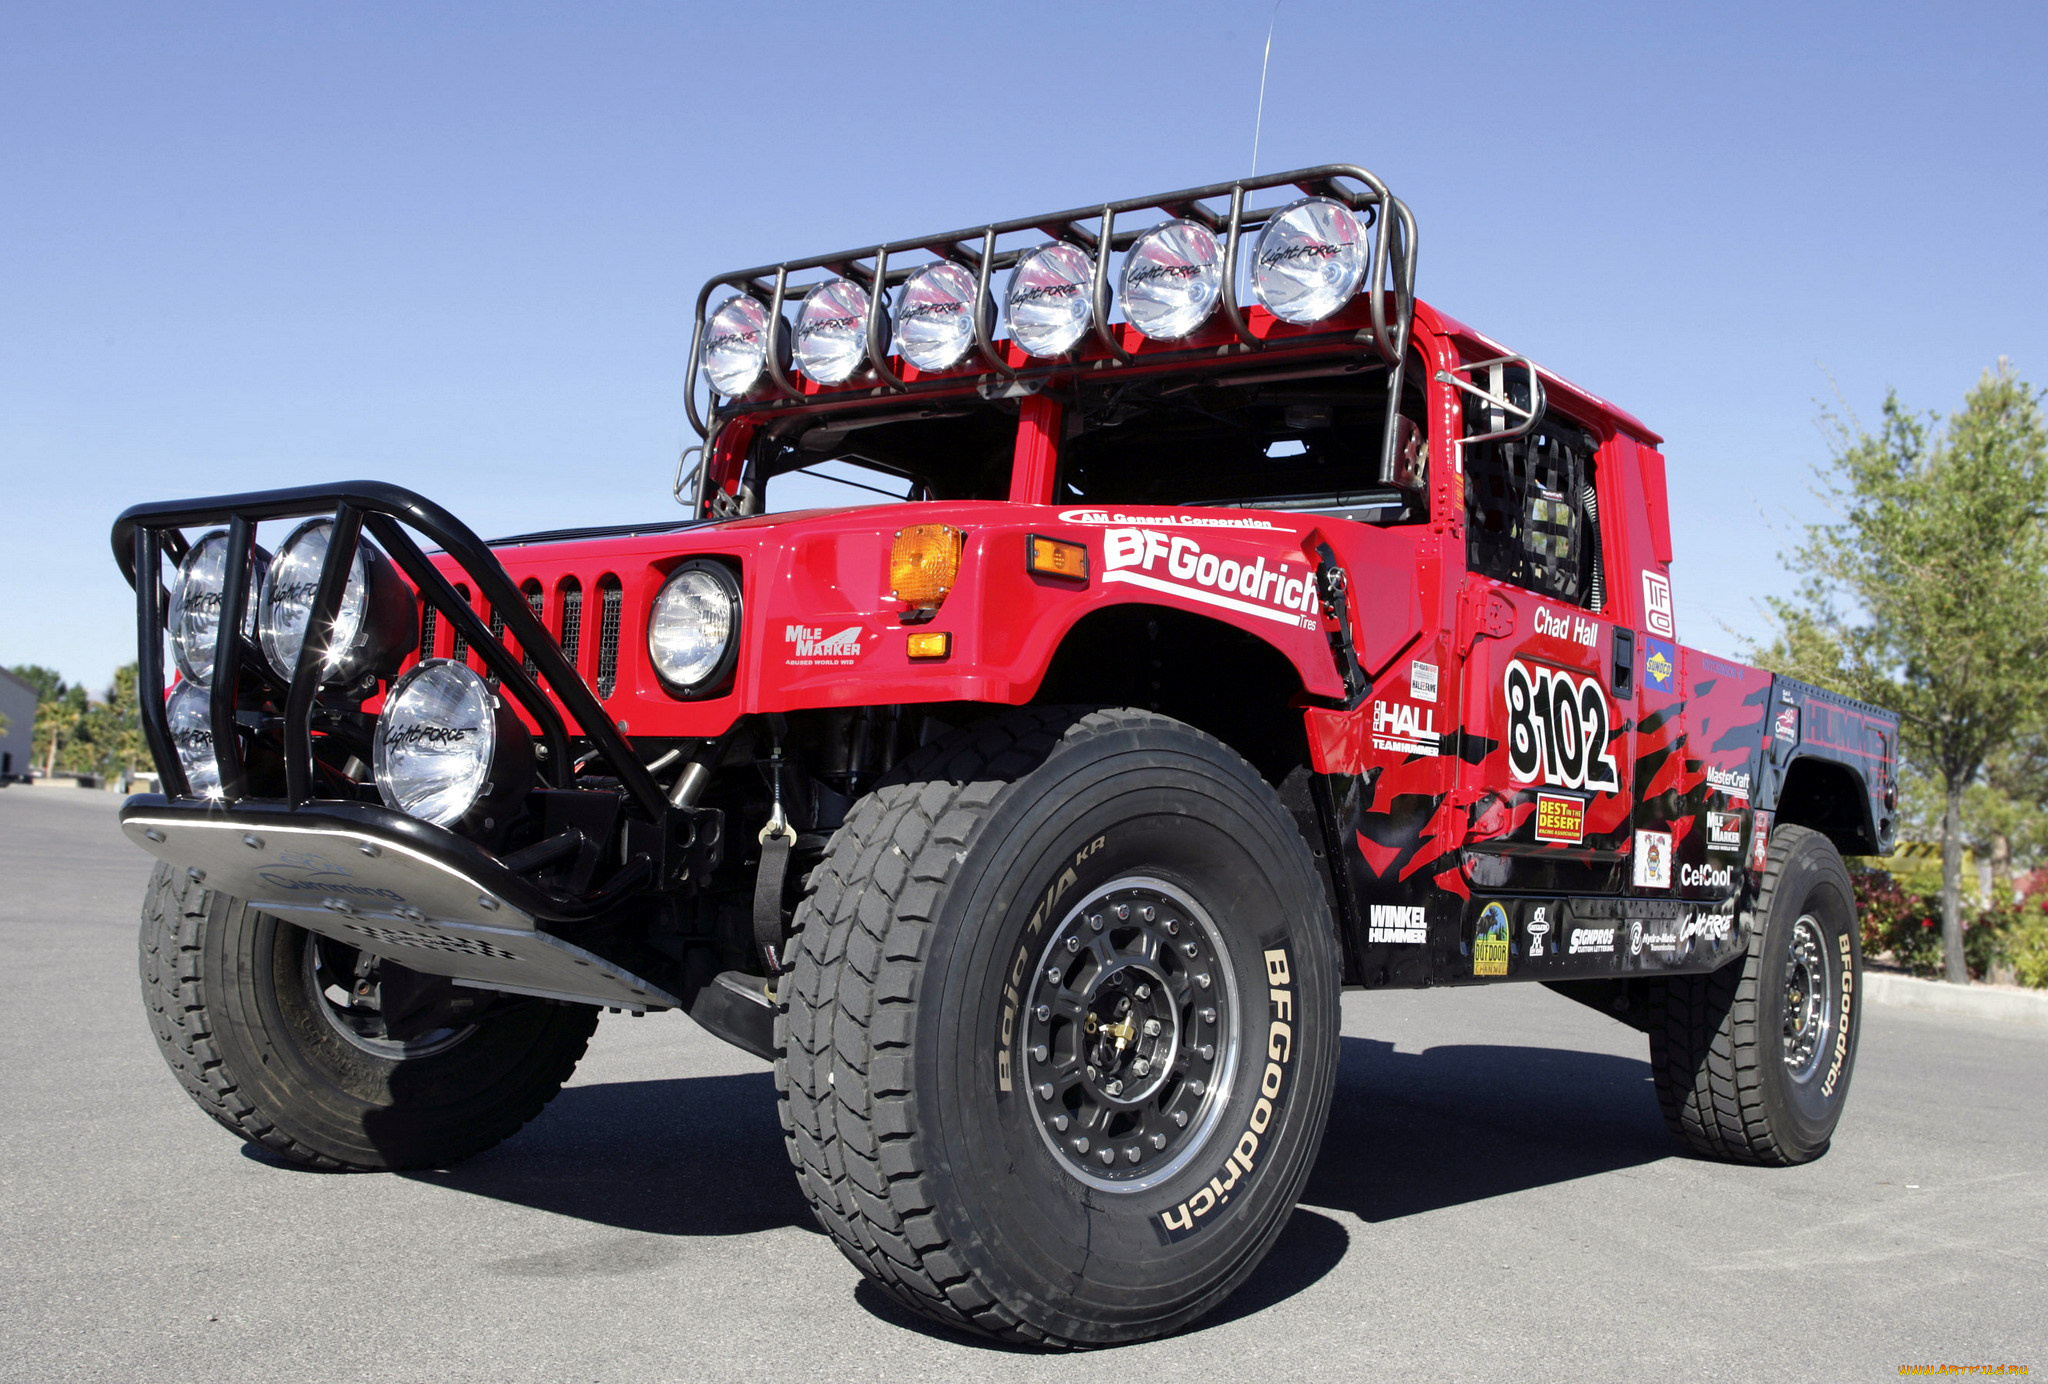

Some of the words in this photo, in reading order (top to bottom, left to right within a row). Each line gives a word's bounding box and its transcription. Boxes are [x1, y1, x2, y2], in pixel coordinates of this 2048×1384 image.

[1081, 513, 1109, 523] AM
[1113, 514, 1175, 525] General
[1180, 516, 1272, 528] Corporation
[1103, 528, 1319, 615] BFGoodrich
[1300, 614, 1317, 632] Tires
[1533, 606, 1570, 640] Chad
[1573, 617, 1599, 647] Hall
[1647, 659, 1672, 677] SUNOCO
[1372, 700, 1381, 732] ROD
[1378, 701, 1441, 741] HALL
[1504, 659, 1619, 793] 8102
[1706, 766, 1751, 789] MasterCraft
[1540, 801, 1568, 816] BEST
[1539, 814, 1582, 831] DESERT
[1370, 904, 1428, 929] WINKEL
[1368, 927, 1427, 944] HUMMER
[998, 944, 1029, 1093] Baja
[1076, 835, 1107, 867] KR
[1474, 944, 1508, 962] OUTDOOR
[1821, 933, 1853, 1098] BFGoodrich
[1160, 948, 1296, 1238] BFGoodrich
